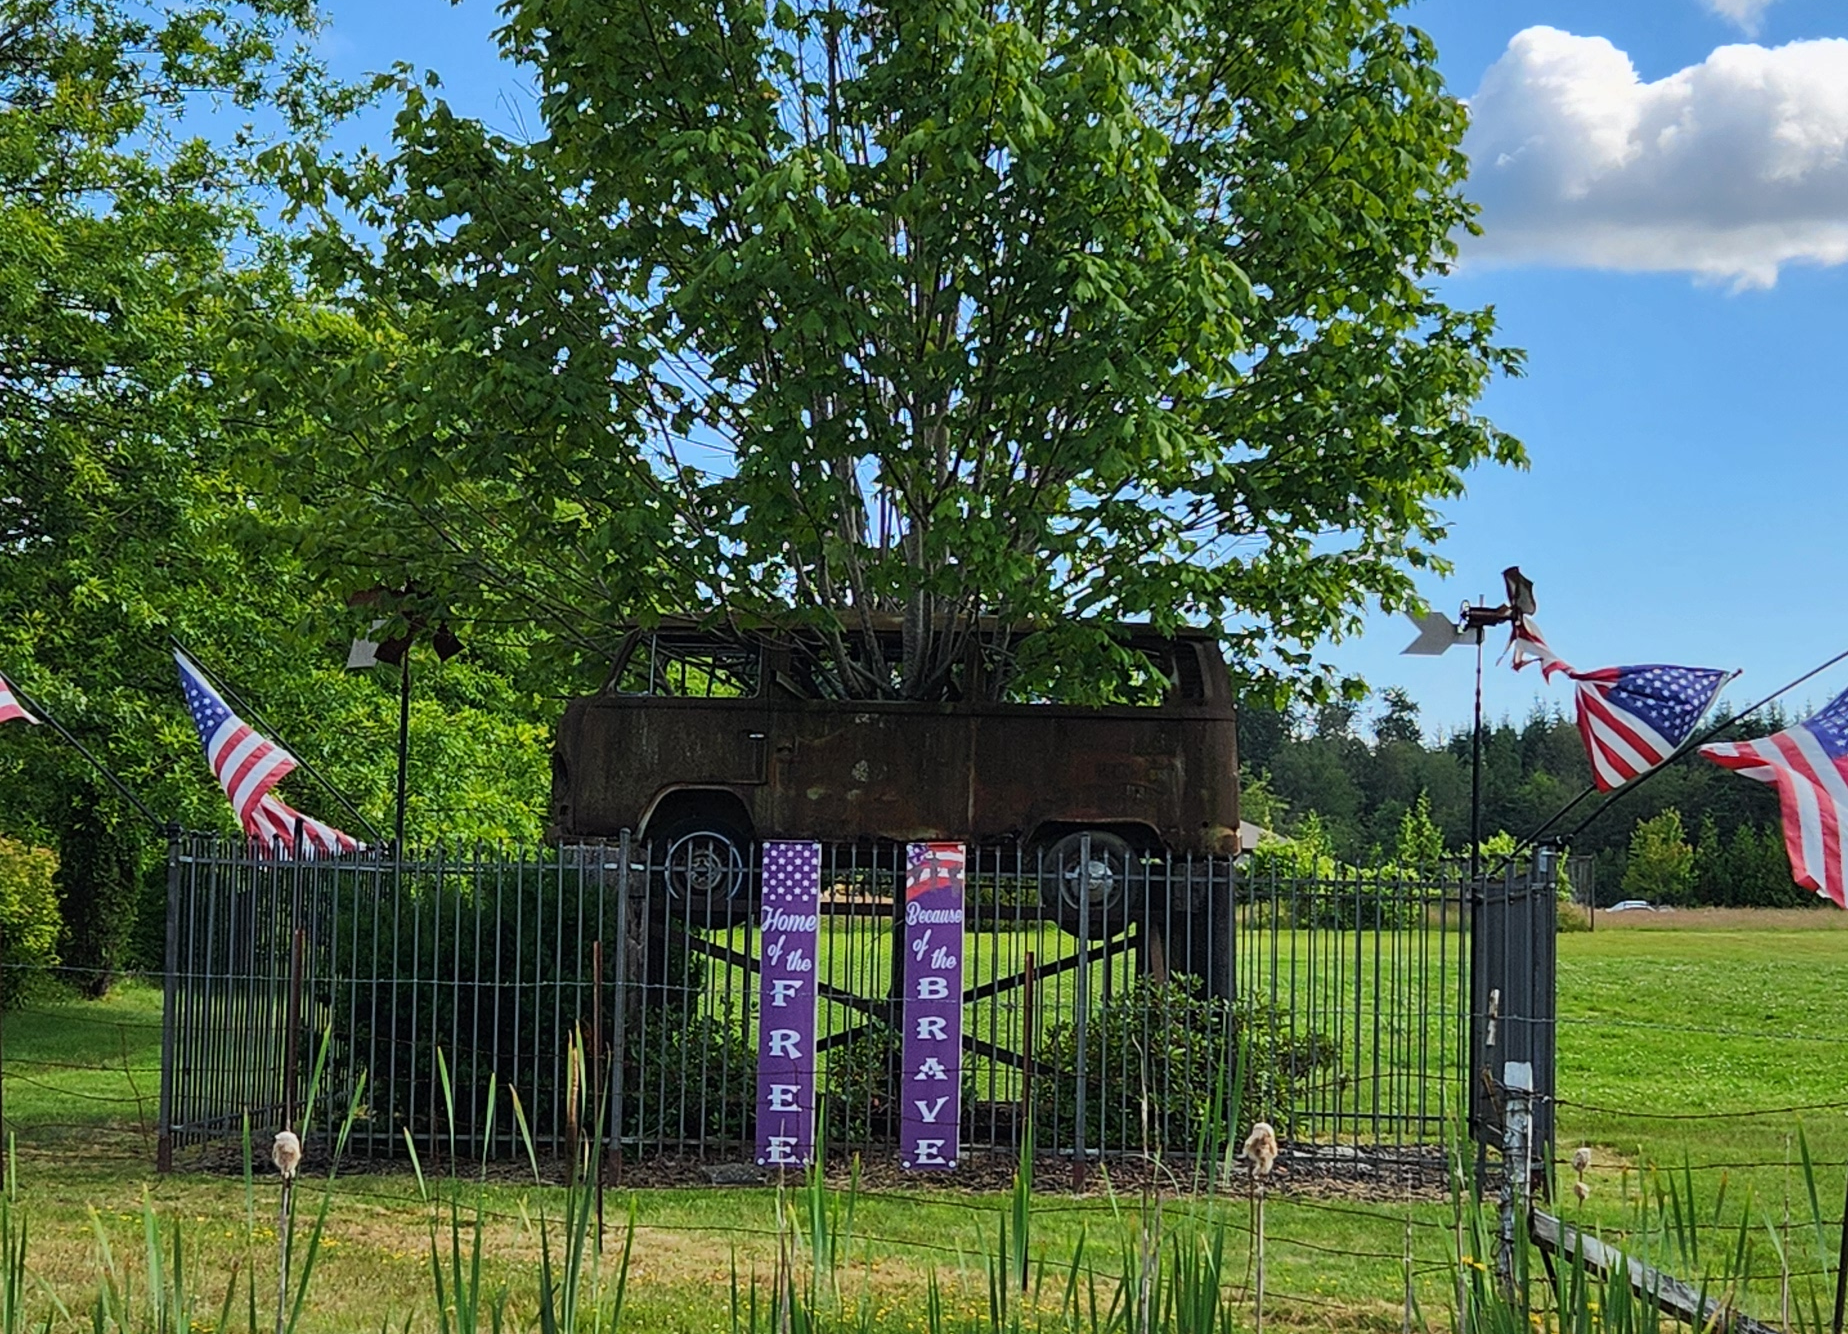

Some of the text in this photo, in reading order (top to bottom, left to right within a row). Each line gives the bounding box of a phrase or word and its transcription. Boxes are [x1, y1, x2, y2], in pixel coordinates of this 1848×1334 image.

[761, 905, 816, 932] Home
[905, 901, 962, 925] Because
[767, 934, 812, 971] of the
[912, 928, 956, 969] of the
[767, 979, 803, 1164] FREE
[914, 976, 949, 1164] BRAVE
